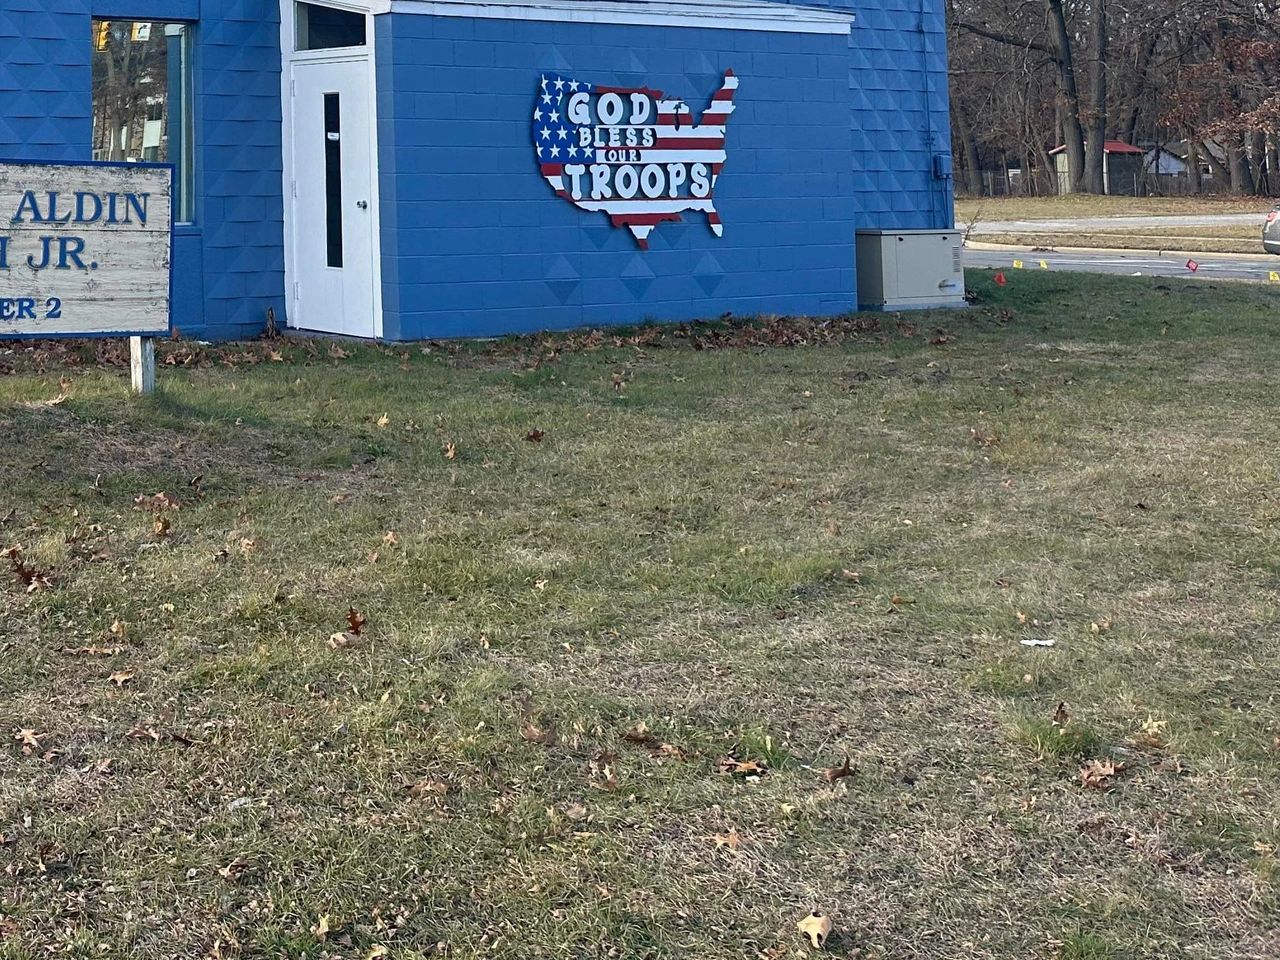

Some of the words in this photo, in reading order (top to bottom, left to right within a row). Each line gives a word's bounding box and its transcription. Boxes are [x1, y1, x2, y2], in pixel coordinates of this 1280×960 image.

[568, 93, 650, 125] GOD
[579, 127, 654, 148] BLESS
[608, 150, 638, 162] OUR
[565, 163, 710, 200] TROOPS
[11, 190, 150, 226] ALDIN
[26, 235, 98, 271] JR.
[44, 296, 62, 319] 2
